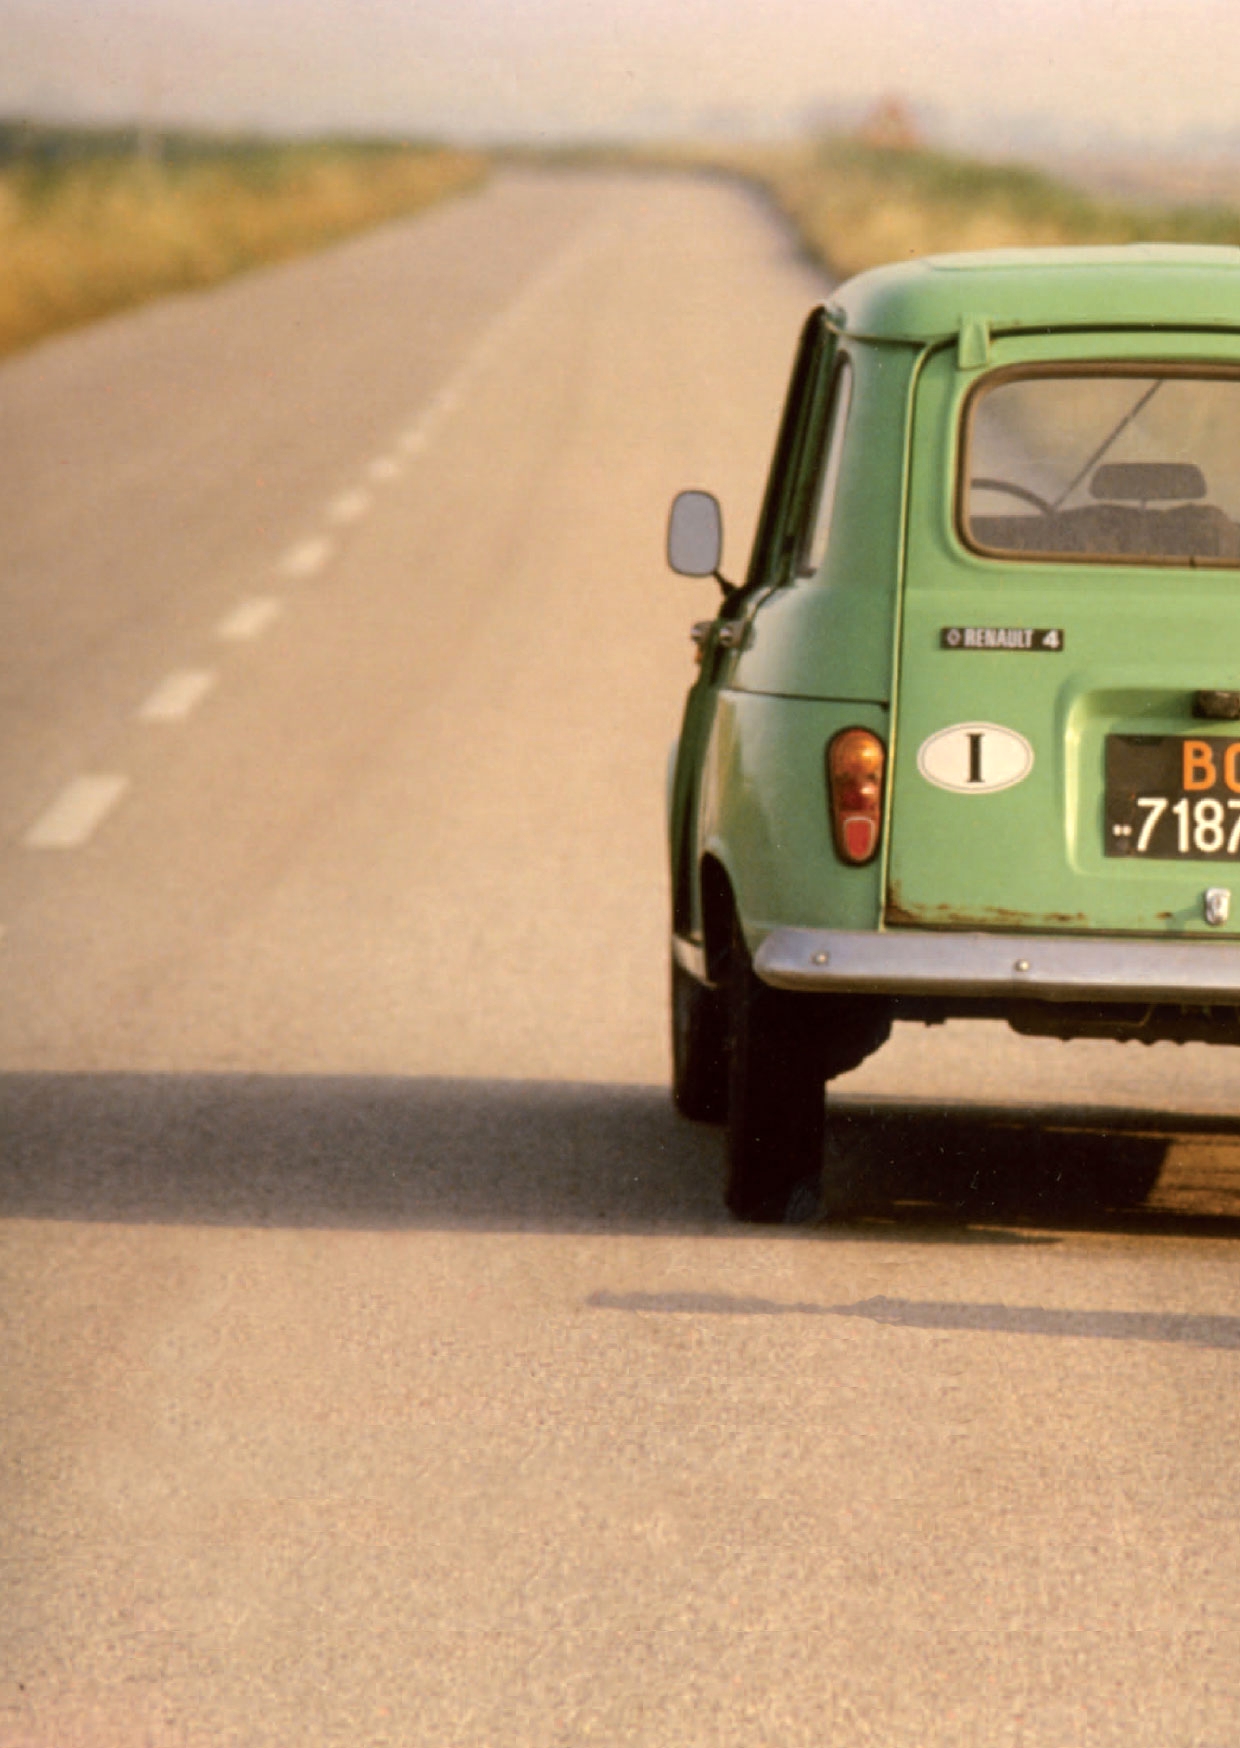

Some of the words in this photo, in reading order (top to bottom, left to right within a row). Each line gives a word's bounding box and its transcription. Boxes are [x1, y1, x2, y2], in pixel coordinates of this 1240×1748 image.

[963, 628, 1033, 649] RENAULT
[1042, 628, 1060, 649] 4
[966, 732, 985, 783] I
